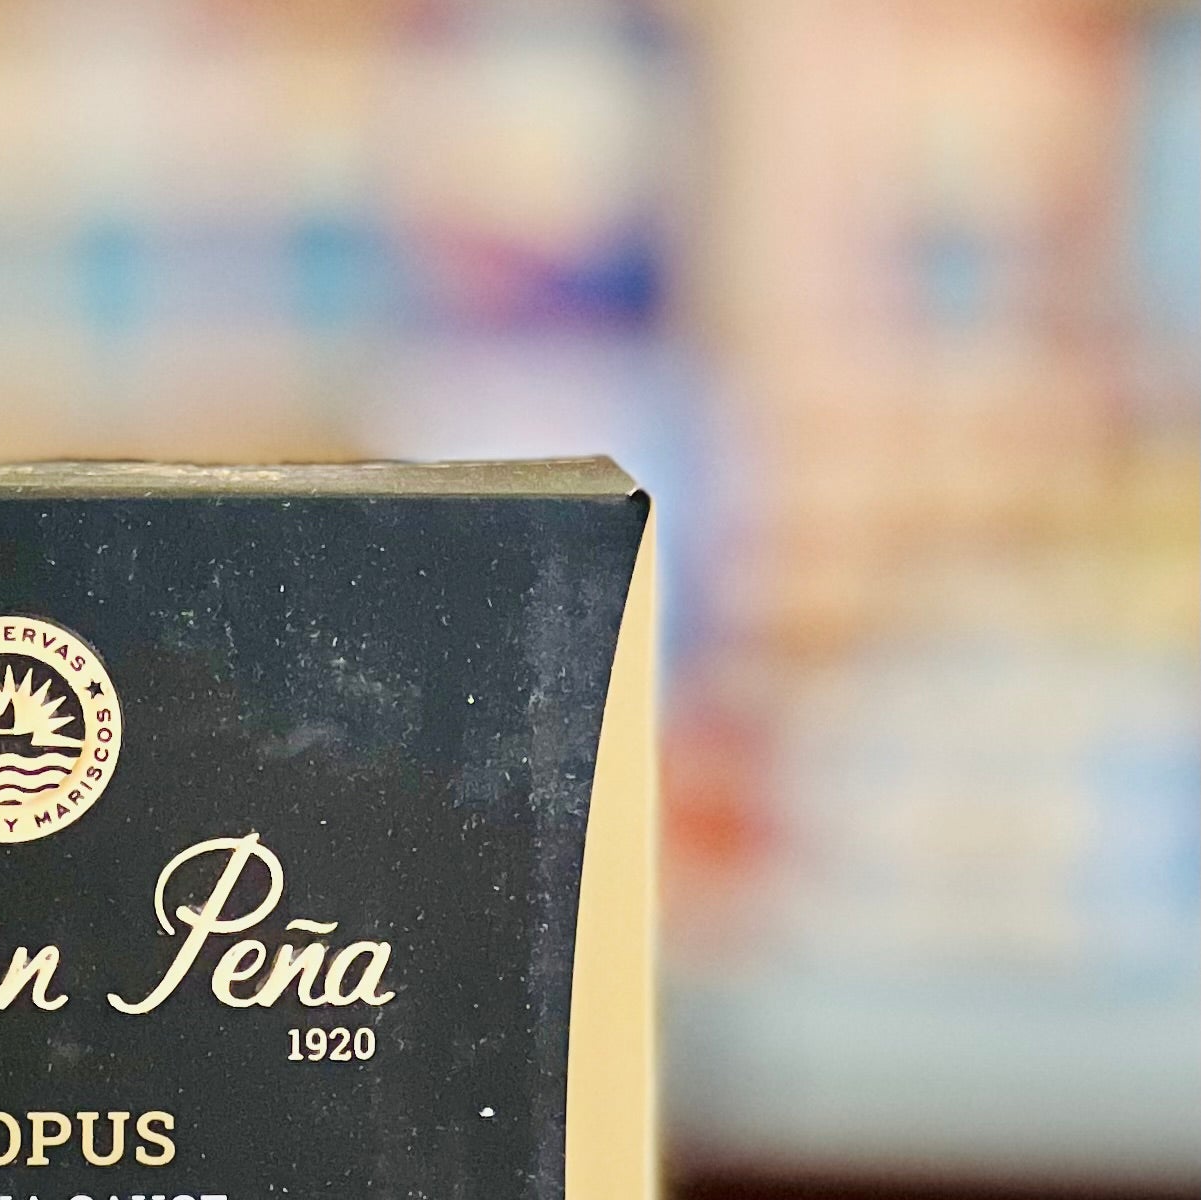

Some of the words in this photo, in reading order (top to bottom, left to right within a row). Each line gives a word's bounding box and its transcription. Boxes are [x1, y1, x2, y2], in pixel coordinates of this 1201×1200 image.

[4, 818, 18, 832] Y
[34, 707, 113, 828] MARISCOS
[107, 832, 396, 1015] Peña
[287, 1027, 377, 1062] 1920
